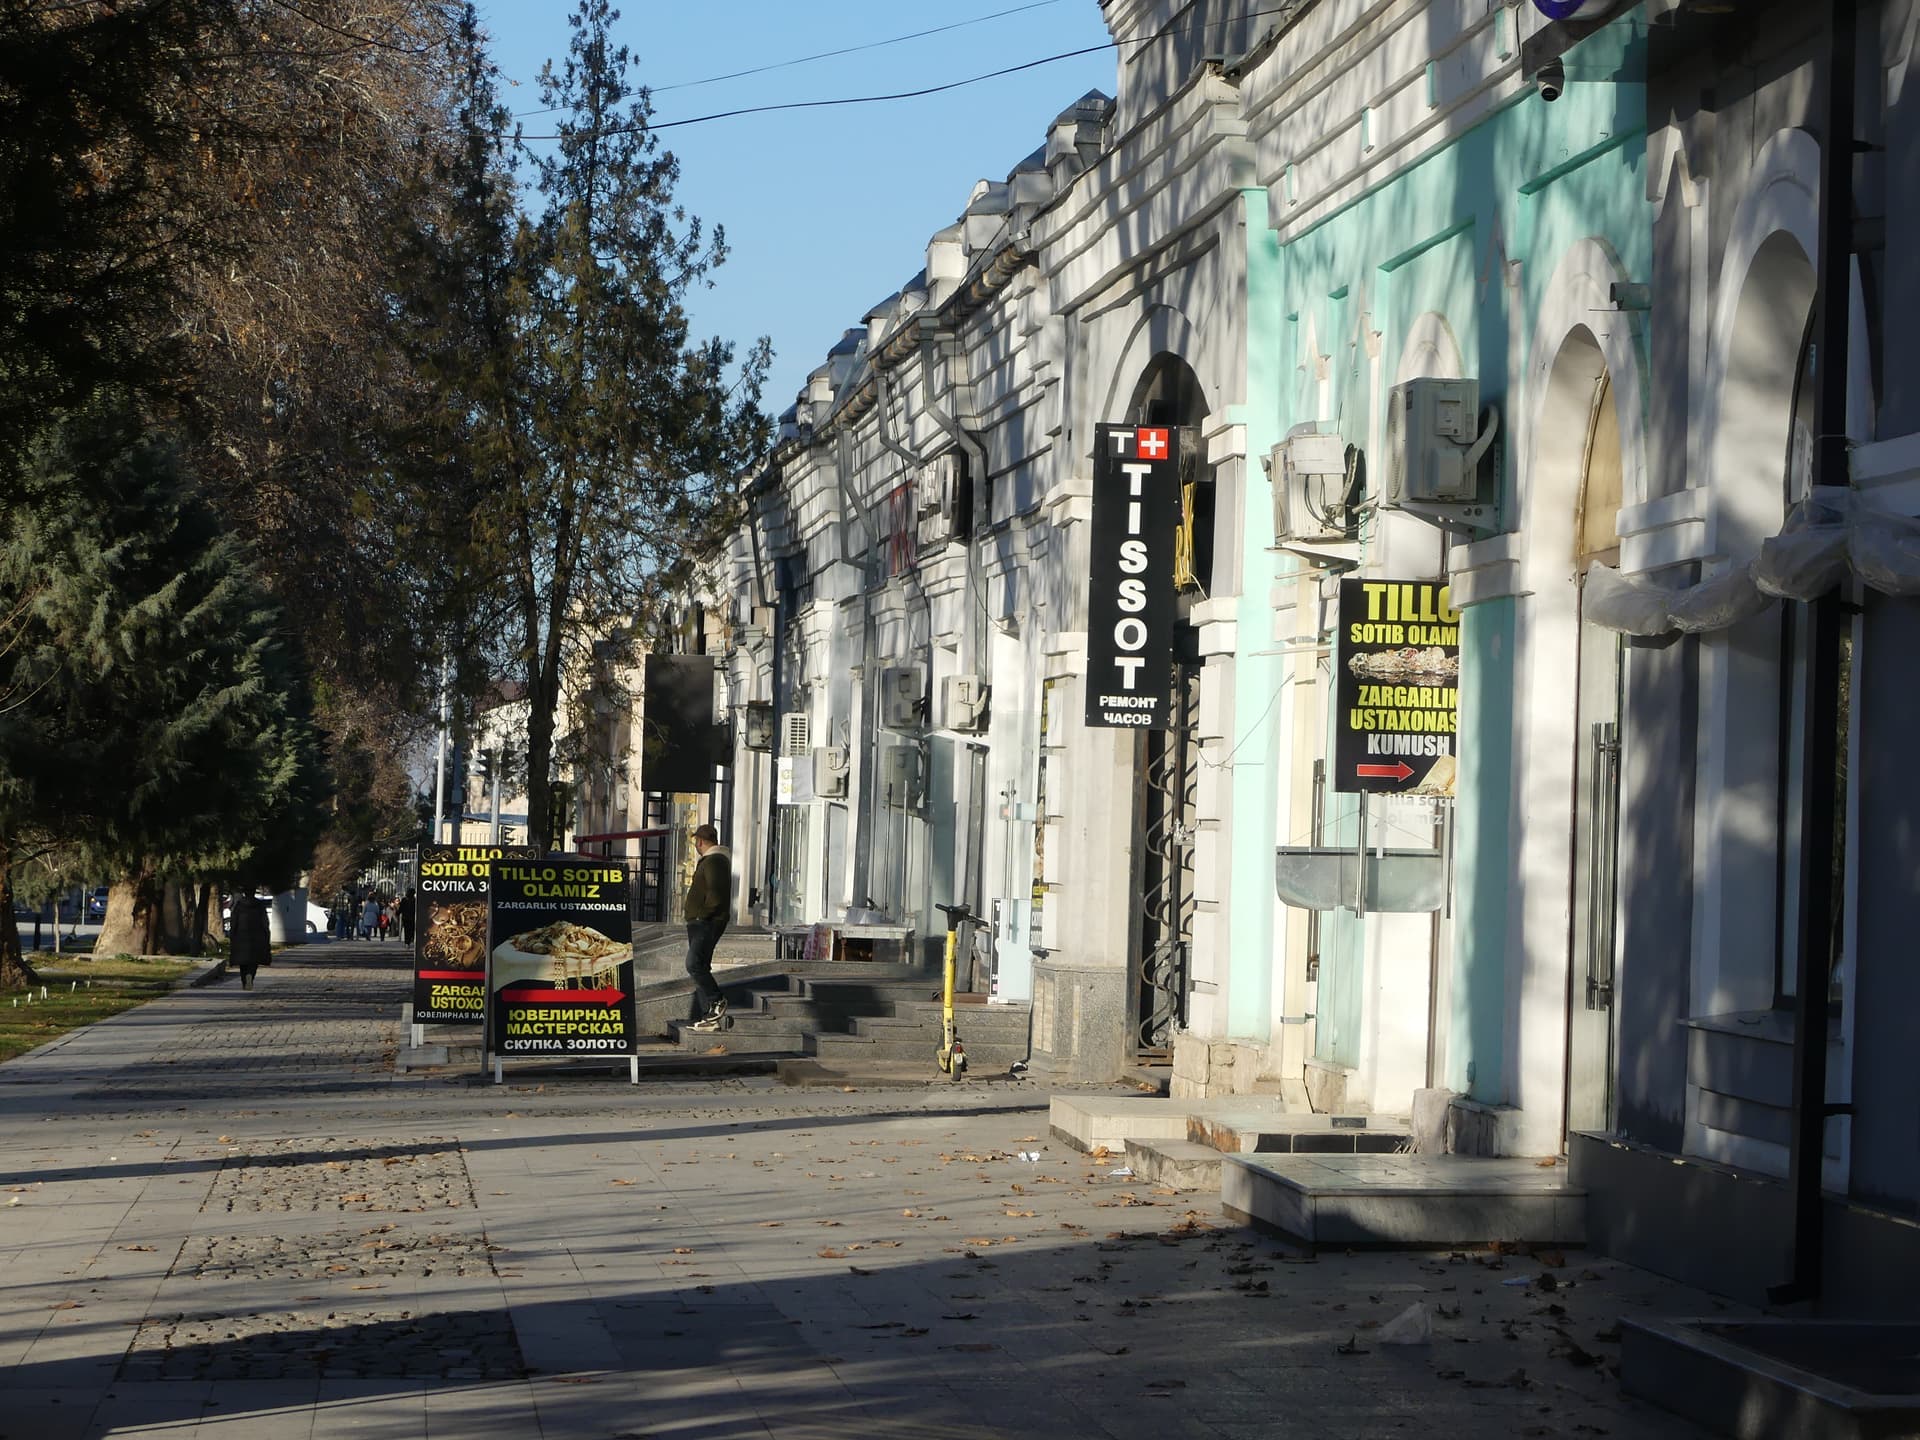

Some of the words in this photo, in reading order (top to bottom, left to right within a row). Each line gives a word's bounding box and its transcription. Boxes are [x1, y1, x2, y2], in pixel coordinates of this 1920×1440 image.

[1114, 464, 1152, 689] TISSOT
[1351, 623, 1403, 644] SOTIB
[1099, 695, 1158, 708] РЕМОНТ
[1104, 712, 1152, 725] ЧАСОВ
[1351, 709, 1457, 733] USTAXONAS
[1368, 734, 1450, 757] KUMUSH
[457, 847, 503, 861] TILLO
[421, 862, 469, 877] SOTIB
[499, 867, 557, 881] TILLO
[563, 868, 623, 883] SOTIB
[422, 880, 475, 892] СКУПКА
[479, 881, 490, 892] З
[523, 883, 601, 898] OLAMIZ
[497, 901, 557, 910] ZARGARLIK
[561, 902, 627, 911] USTAXONASI
[431, 996, 484, 1010] USTOXO
[417, 1011, 470, 1019] ЮВЕЛИРНАЯ
[509, 1009, 621, 1021] ЮВЕЛИРНАЯ
[506, 1023, 624, 1035] МАСТЕРСКАЯ
[504, 1039, 563, 1050] СКУПКА
[566, 1039, 628, 1049] ЗОЛОТО
